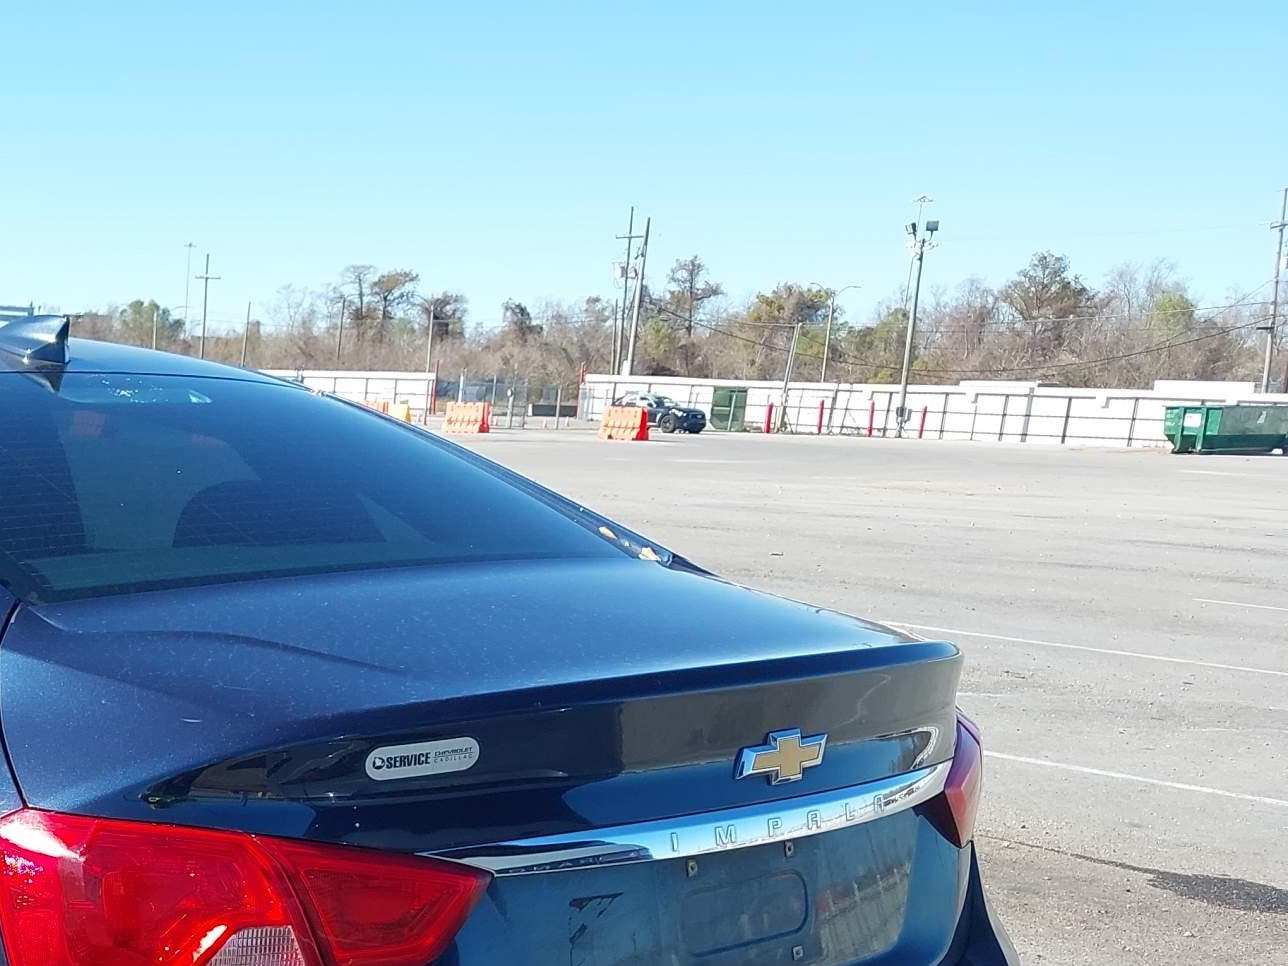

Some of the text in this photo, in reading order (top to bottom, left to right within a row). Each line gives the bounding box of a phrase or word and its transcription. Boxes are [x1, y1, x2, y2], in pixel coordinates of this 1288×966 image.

[386, 752, 431, 769] SERVICE
[434, 754, 473, 763] CADILLAC
[669, 793, 885, 853] IMPALA
